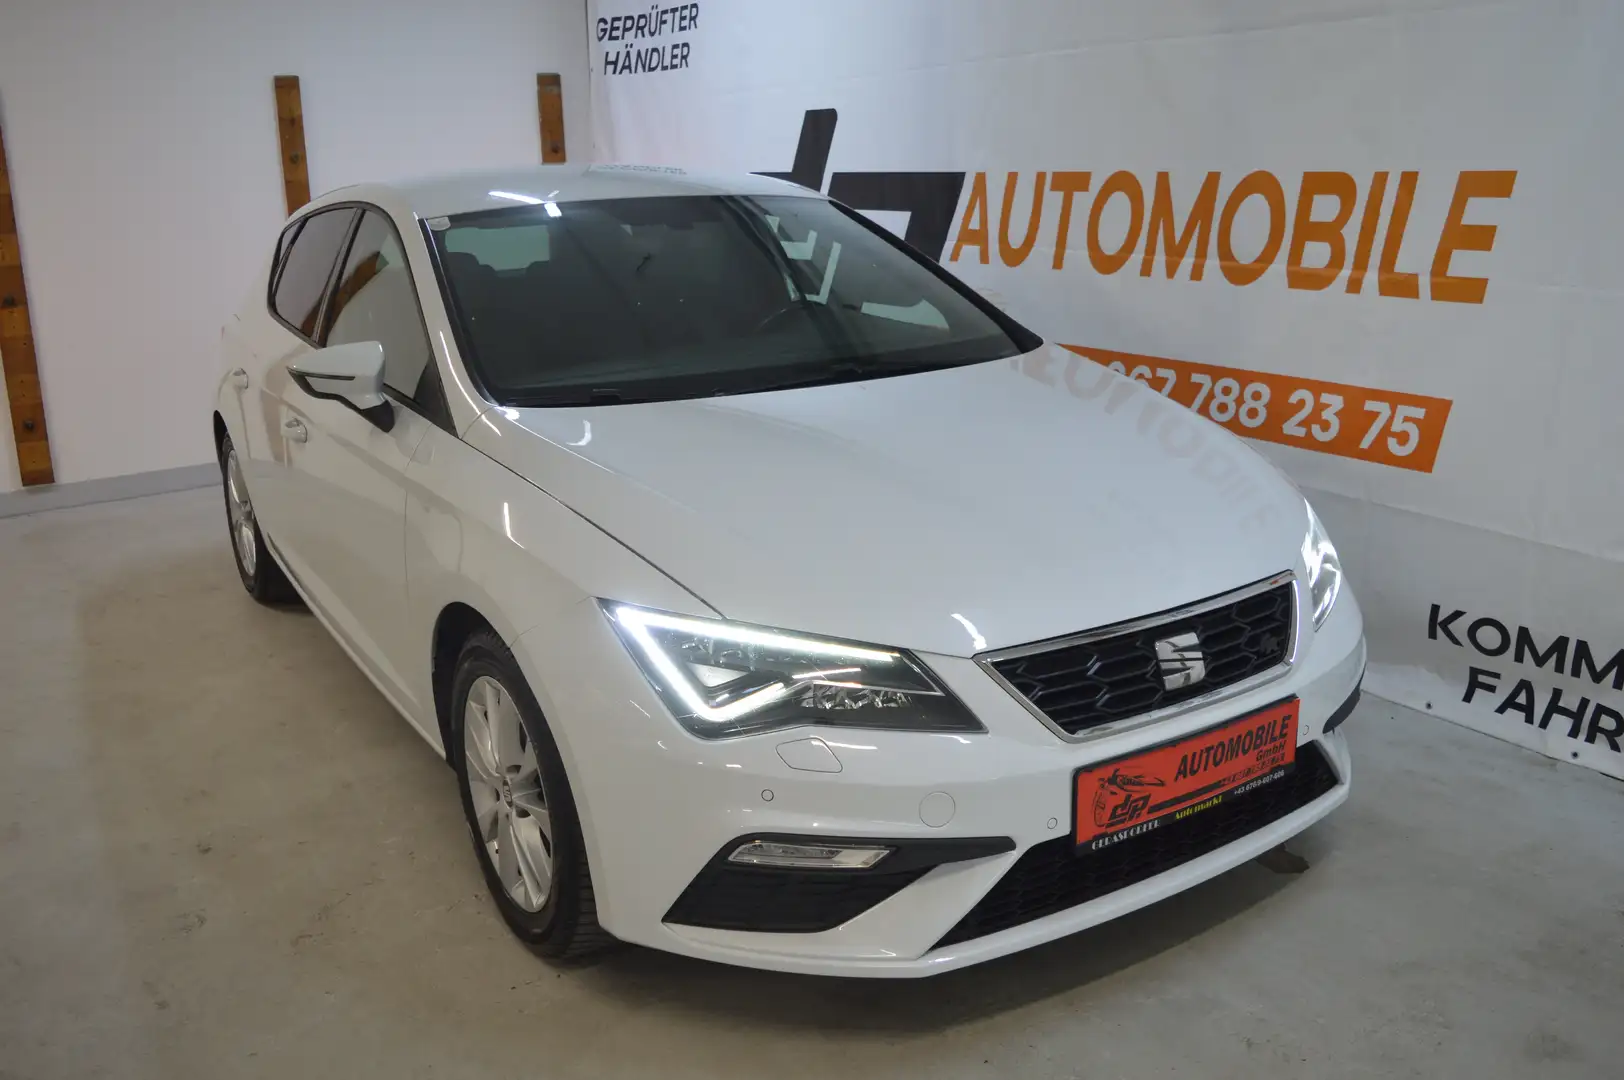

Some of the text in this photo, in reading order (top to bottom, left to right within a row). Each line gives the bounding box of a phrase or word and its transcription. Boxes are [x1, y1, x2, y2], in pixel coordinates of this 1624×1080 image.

[596, 2, 699, 42] GEPRÜFTER
[604, 42, 690, 75] HÄNDLER
[950, 169, 1518, 305] AUTOMOBILE
[1187, 373, 1272, 428] 788
[1282, 389, 1345, 443] 23
[1359, 400, 1427, 457] 75
[1428, 603, 1624, 691] KOMM
[1462, 666, 1624, 753] FAHR
[1174, 714, 1292, 782] AUTOMOBILE
[1256, 740, 1285, 762] GmbH
